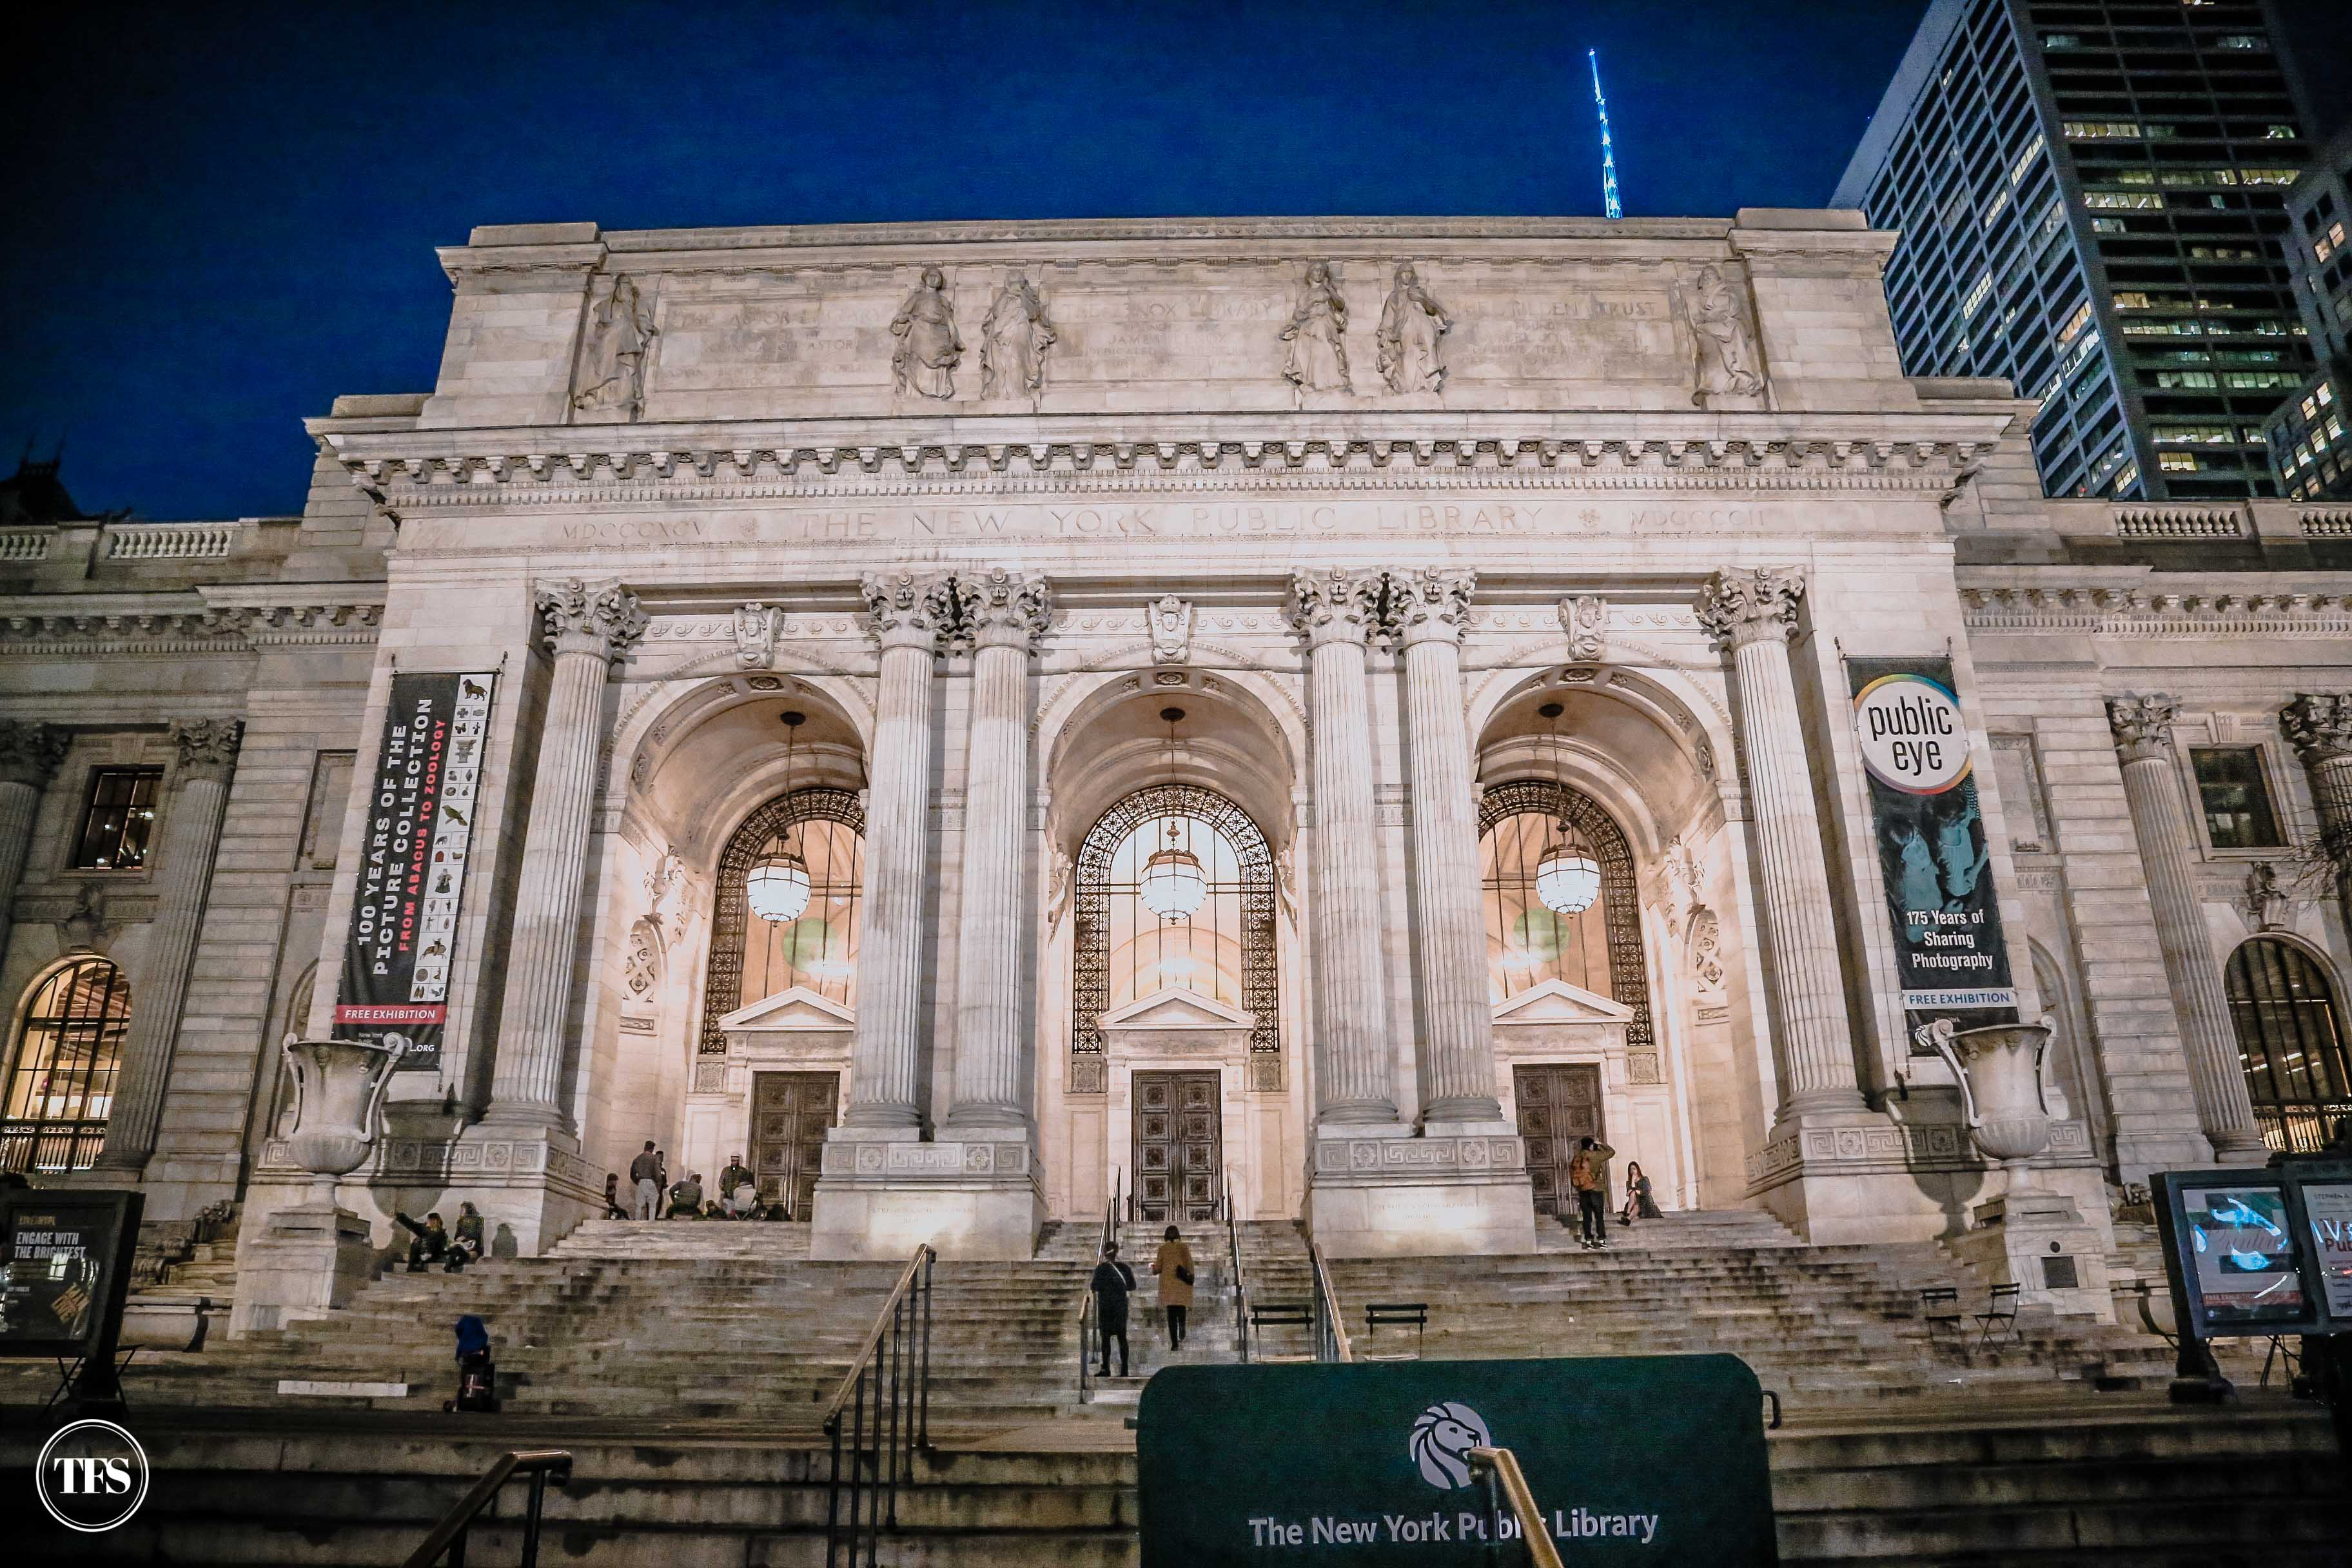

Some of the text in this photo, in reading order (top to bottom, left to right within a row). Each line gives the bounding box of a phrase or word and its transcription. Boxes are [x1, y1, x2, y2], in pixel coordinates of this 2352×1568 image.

[562, 520, 708, 540] MDCCCXCV
[796, 513, 877, 537] THE
[911, 511, 1012, 534] NEW
[1049, 509, 1156, 533] YORK
[1191, 506, 1337, 531] PUBLIC
[1377, 505, 1543, 529] LIBRARY
[1868, 696, 1952, 741] public
[1892, 741, 1943, 776] eye
[357, 725, 407, 946] 100 YEARS OF THE
[373, 699, 433, 974] PICTURE COLLECTION
[398, 720, 447, 951] FROM ABACUS TO ZOOLOGY
[1906, 908, 1984, 925] 175 Years of
[1923, 931, 1975, 949] Sharing
[1912, 952, 1993, 971] Photography
[1908, 993, 2010, 1004] FREE EXHIBITION
[345, 1010, 436, 1019] FREE EXHIBITION
[15, 1232, 79, 1245] ENGAGE WITH
[15, 1246, 33, 1259] THE
[1248, 1516, 1303, 1546] The
[1311, 1516, 1377, 1544] New
[1383, 1512, 1451, 1542] York
[1556, 1507, 1658, 1544] Library
